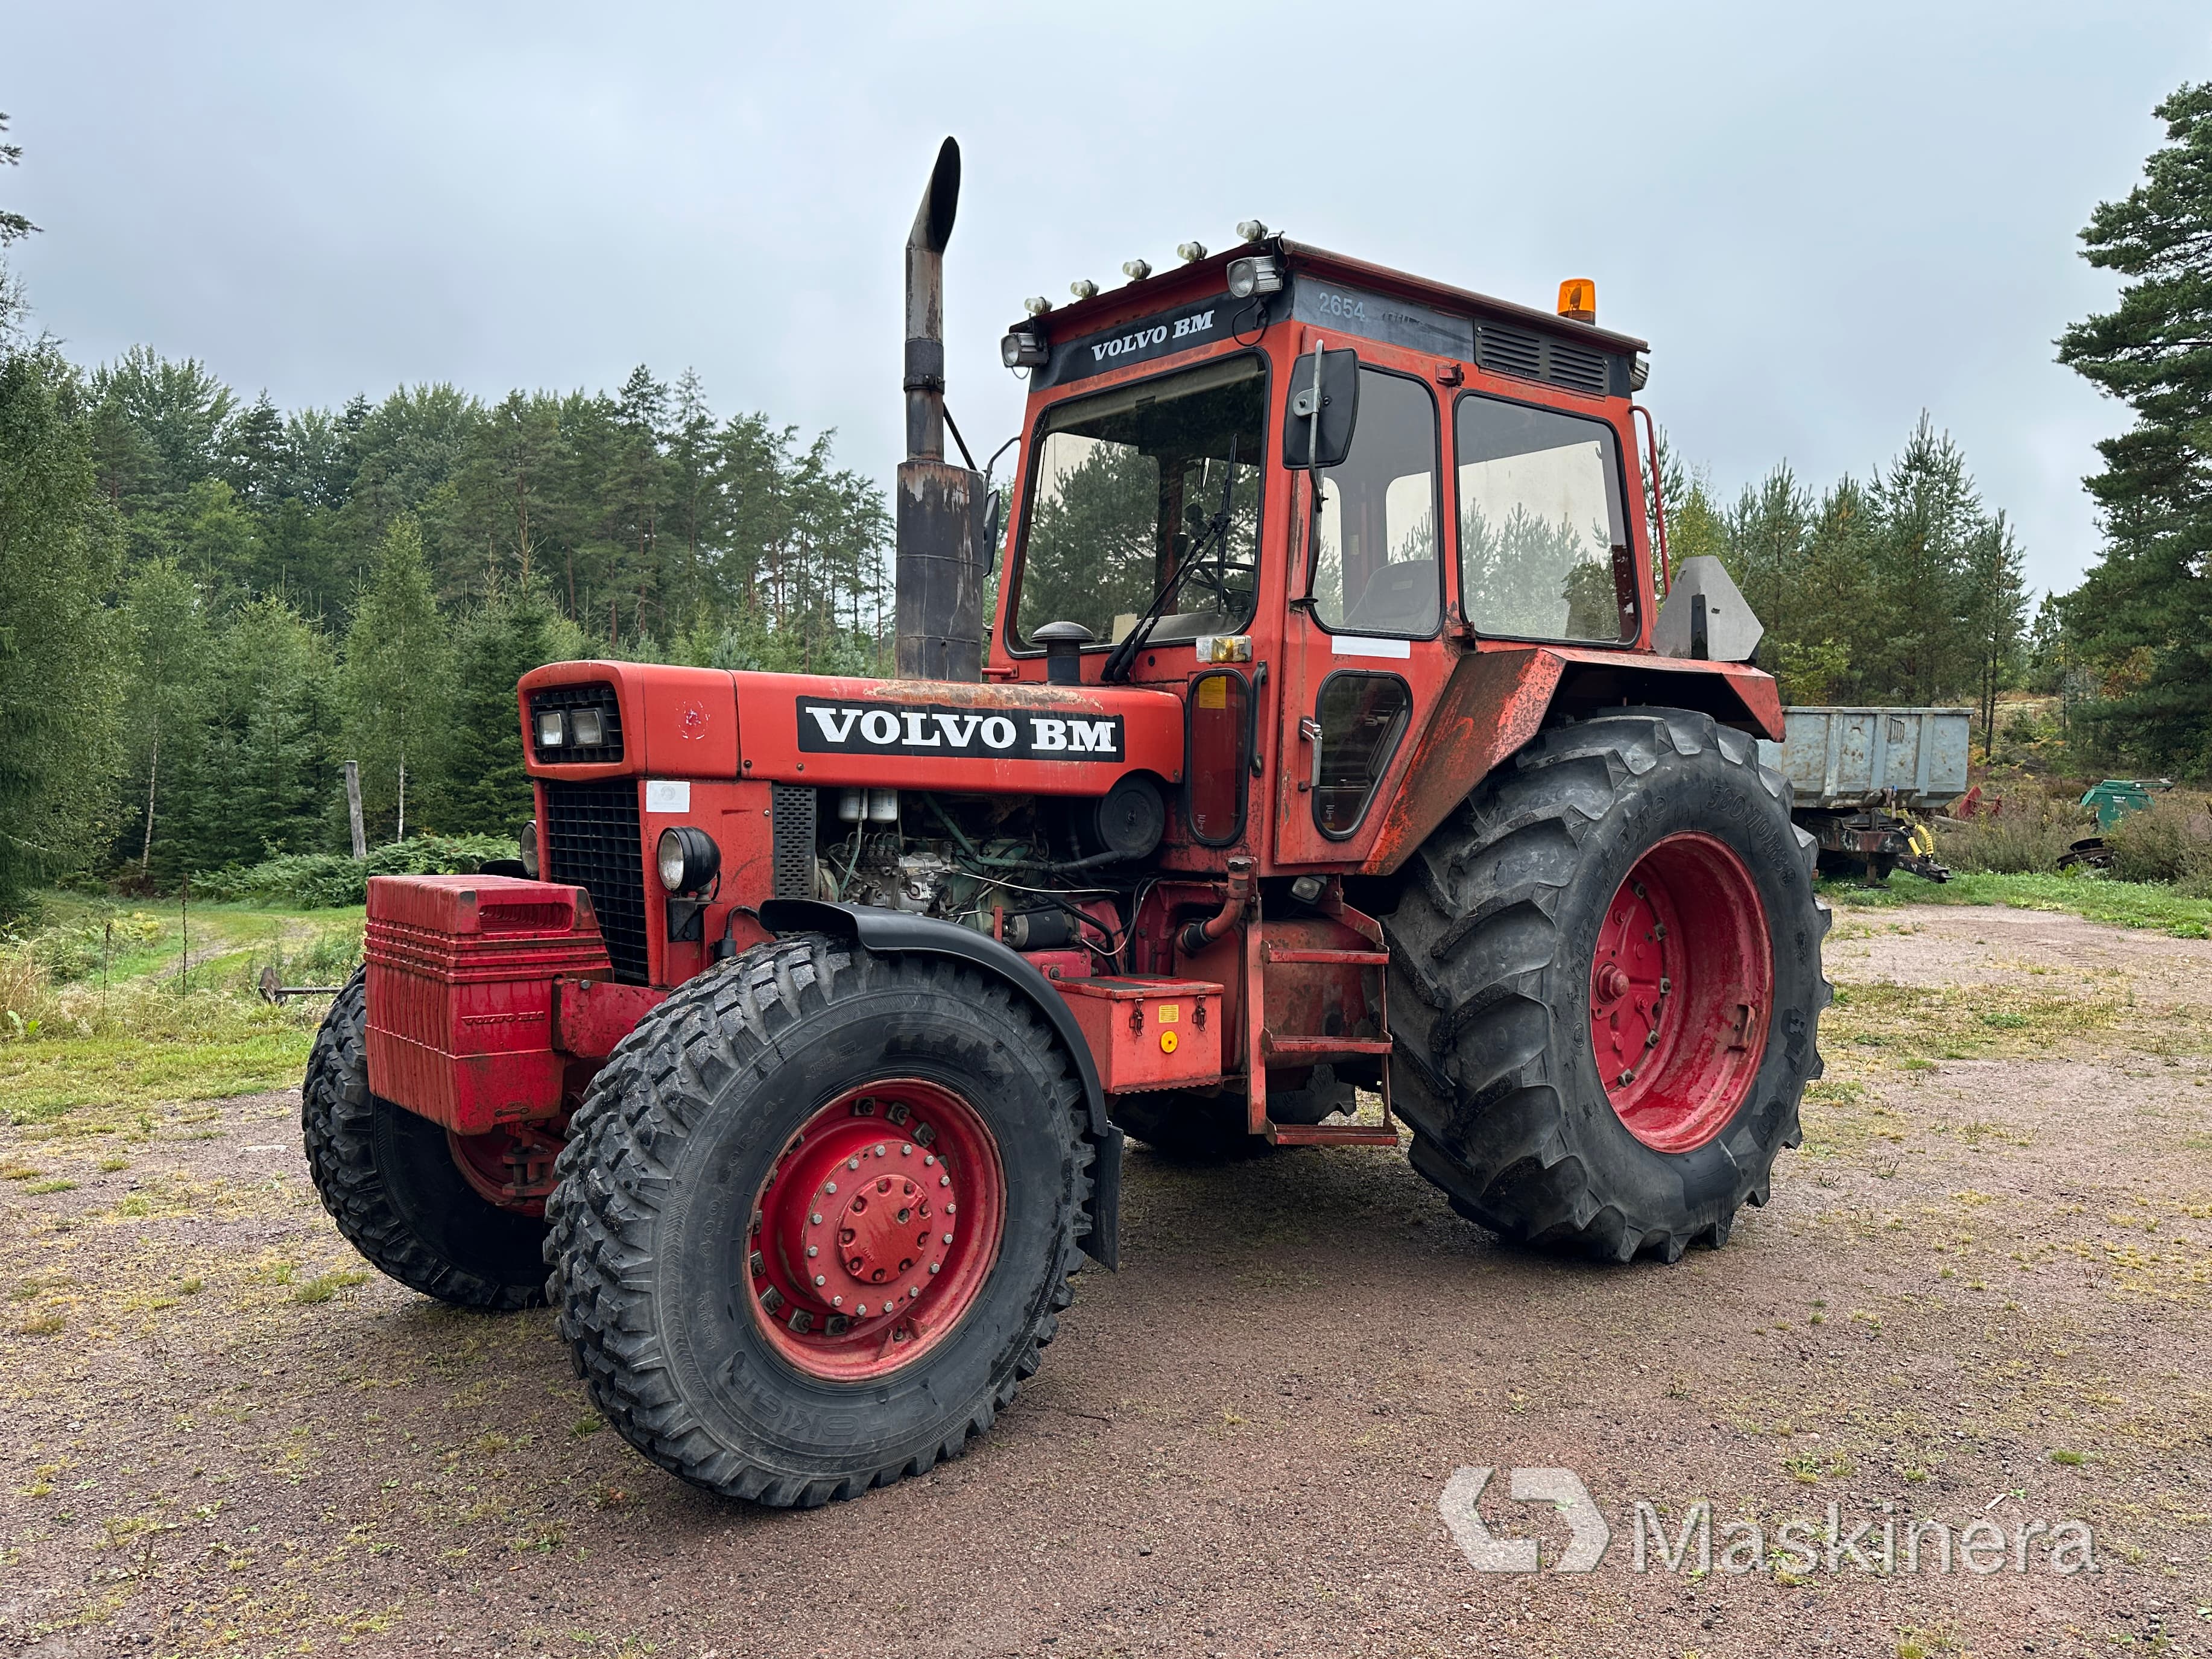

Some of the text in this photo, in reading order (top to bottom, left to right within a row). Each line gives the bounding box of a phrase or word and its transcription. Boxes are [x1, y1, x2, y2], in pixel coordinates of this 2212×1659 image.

[1319, 292, 1365, 321] 2654
[1091, 310, 1215, 361] VOLVO BM
[805, 706, 1117, 752] VOLVO BM
